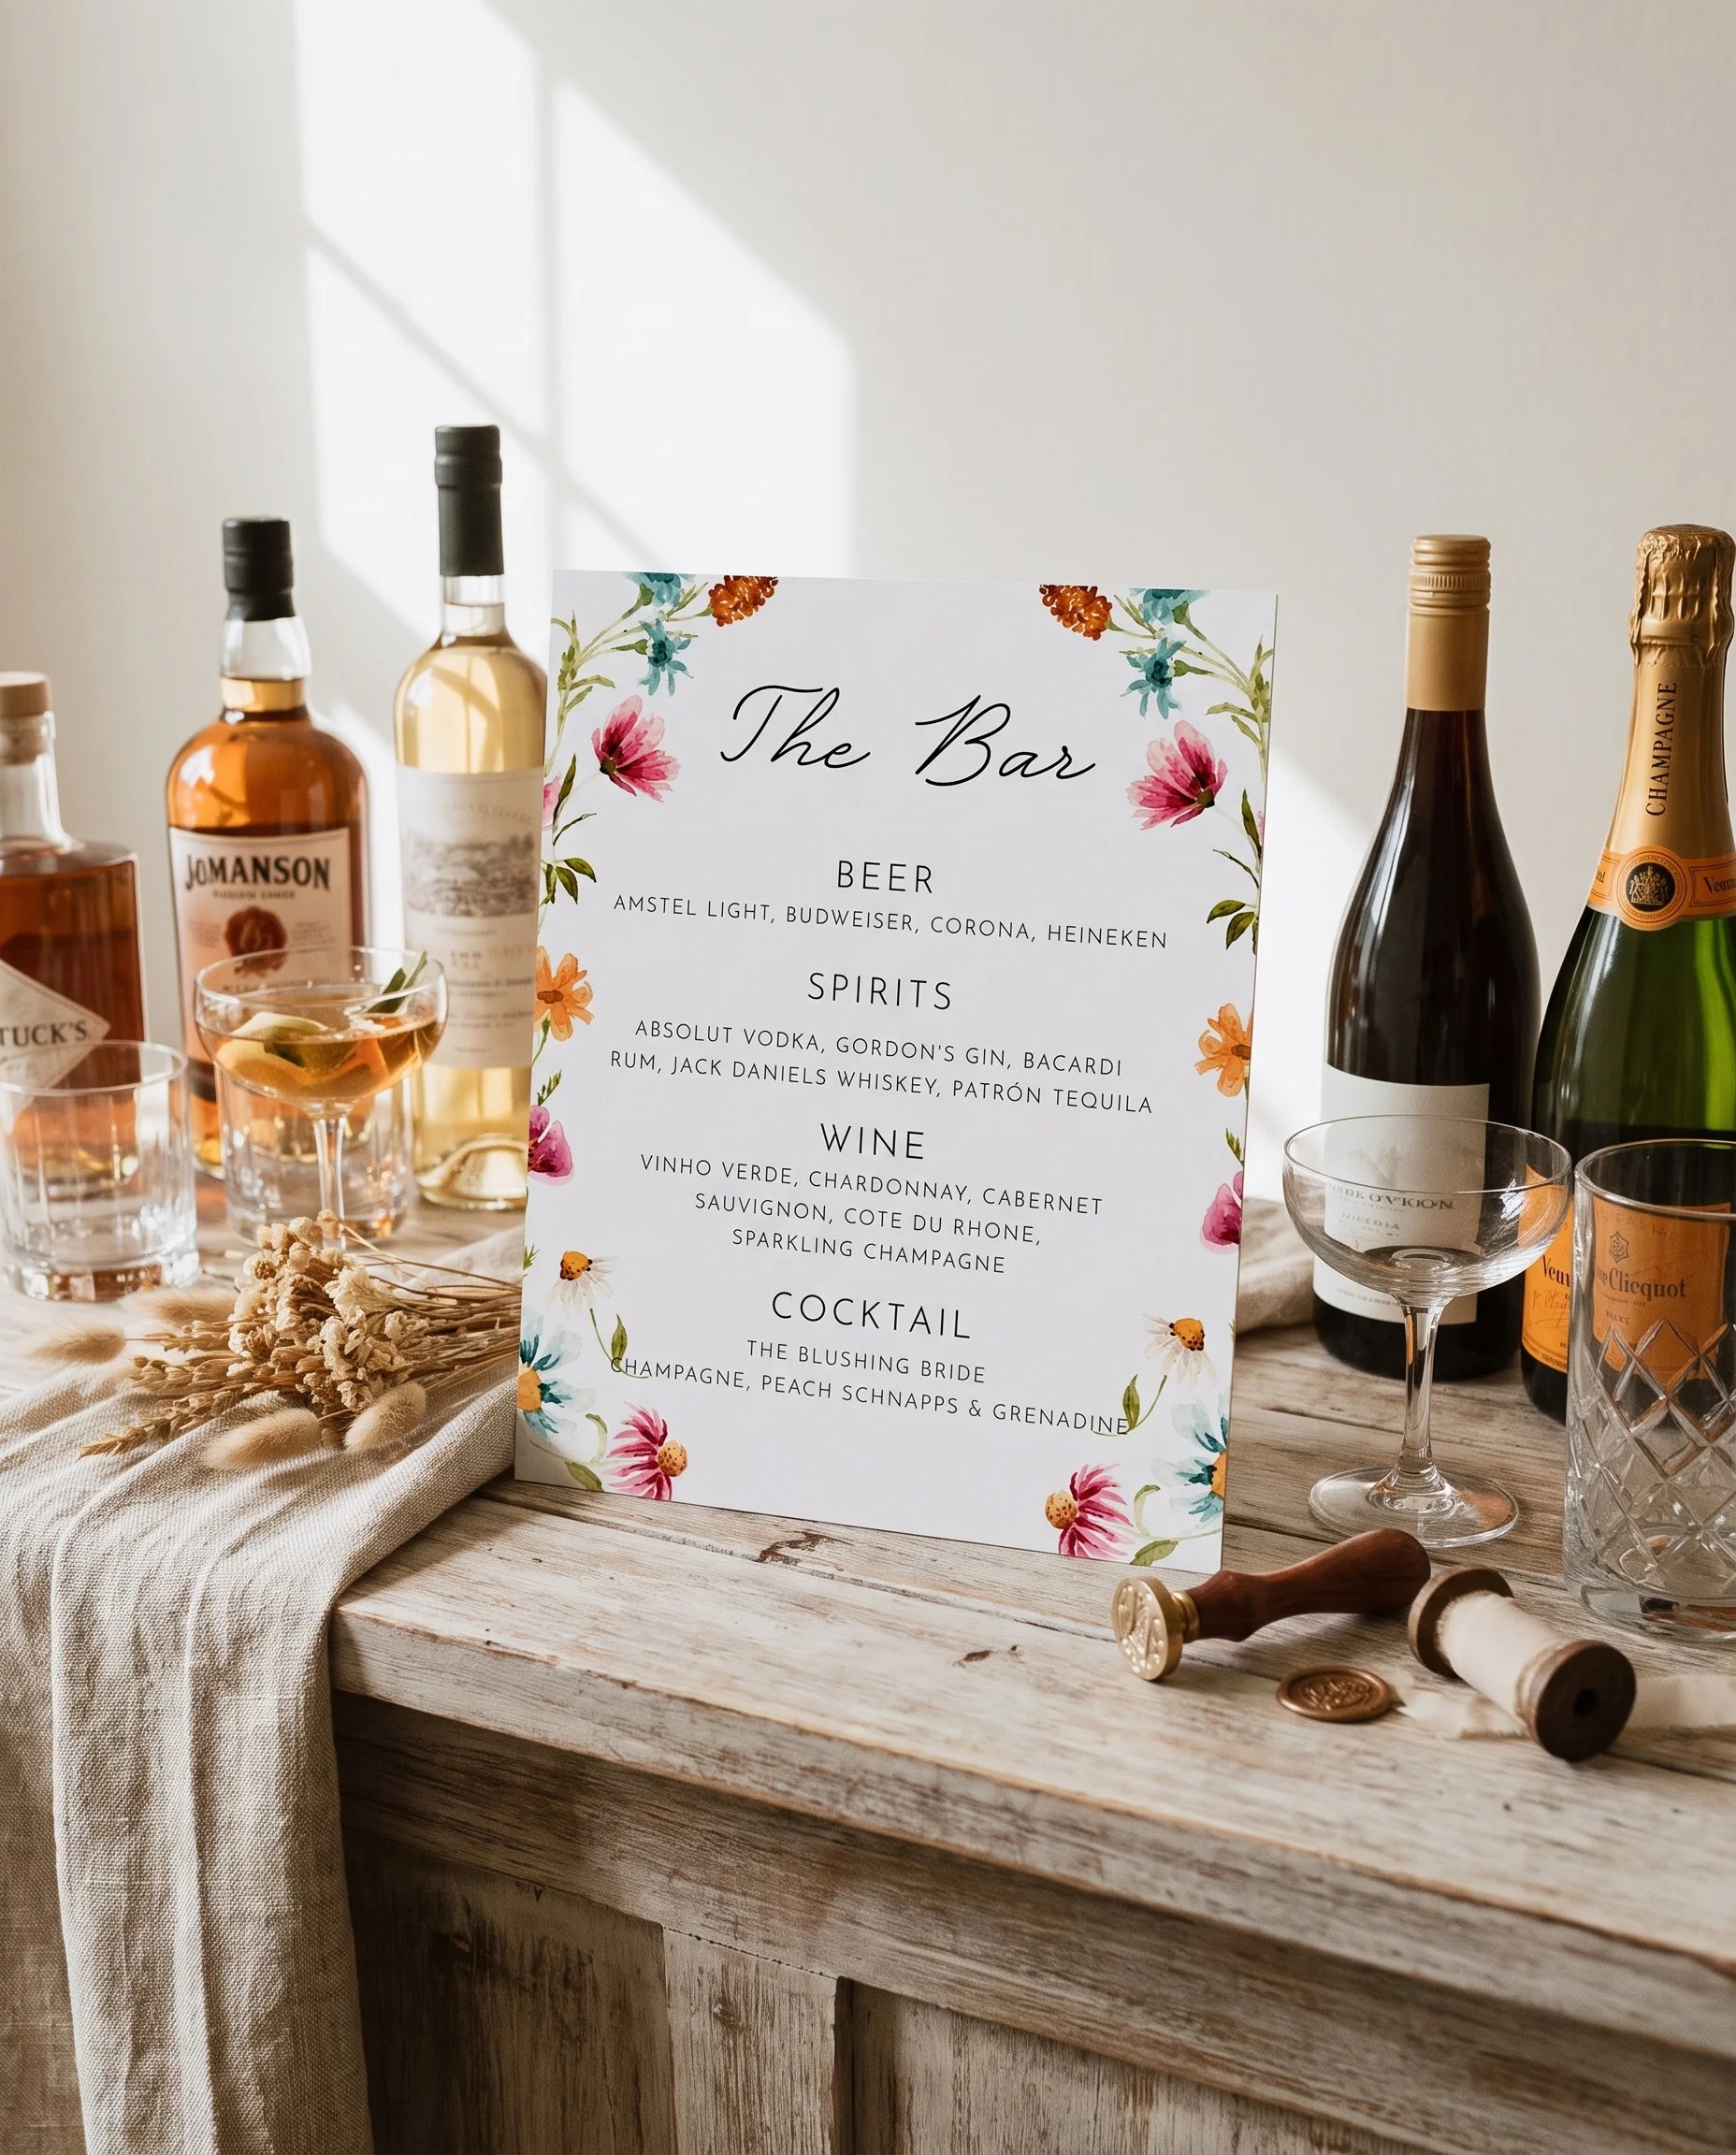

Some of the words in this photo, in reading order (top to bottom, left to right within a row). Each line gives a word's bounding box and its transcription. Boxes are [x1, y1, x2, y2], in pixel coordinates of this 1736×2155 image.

[720, 686, 871, 768] The
[915, 695, 1095, 787] Bar
[1644, 682, 1677, 817] CHAMPAGNE
[838, 861, 932, 893] BEER
[614, 895, 696, 915] AMSTEL
[708, 901, 774, 923] LIGHT,
[788, 906, 919, 933] BUDWEISER,
[932, 917, 1034, 942] CORONA,
[1049, 925, 1165, 948] HEINEKEN
[808, 973, 950, 1009] SPIRITS
[635, 1020, 732, 1043] ABSOLUT
[744, 1029, 824, 1053] VODKA,
[837, 1037, 954, 1062] GORDON'S
[966, 1048, 1010, 1069] GIN,
[1024, 1052, 1121, 1076] BACARDI
[612, 1051, 660, 1073] RUM,
[671, 1057, 721, 1076] JACK
[733, 1062, 825, 1085] DANIELS
[838, 1071, 940, 1097] WHISKEY,
[954, 1080, 1040, 1104] PATRÓN
[1053, 1089, 1151, 1113] TEQUILA
[820, 1123, 923, 1159] WINE
[641, 1154, 711, 1176] VINHO
[722, 1162, 797, 1187] VERDE,
[809, 1171, 971, 1204] CHARDONNAY,
[983, 1188, 1102, 1214] CABERNET
[696, 1193, 832, 1224] SAUVIGNON,
[845, 1208, 901, 1228] COTE
[914, 1215, 941, 1233] DU
[954, 1219, 1039, 1246] RHONE,
[733, 1229, 852, 1256] SPARKLING
[864, 1243, 1005, 1273] CHAMPAGNE
[1609, 1267, 1686, 1301] Clicquot
[773, 1292, 970, 1338] COCKTAIL
[747, 1340, 787, 1360] THE
[800, 1346, 908, 1374] BLUSHING
[921, 1361, 984, 1383] BRIDE
[610, 1356, 749, 1391] CHAMPAGNE,
[762, 1375, 831, 1398] PEACH
[843, 1385, 957, 1413] SCHNAPPS
[969, 1400, 980, 1417] &
[993, 1404, 1129, 1435] GRENADINE
